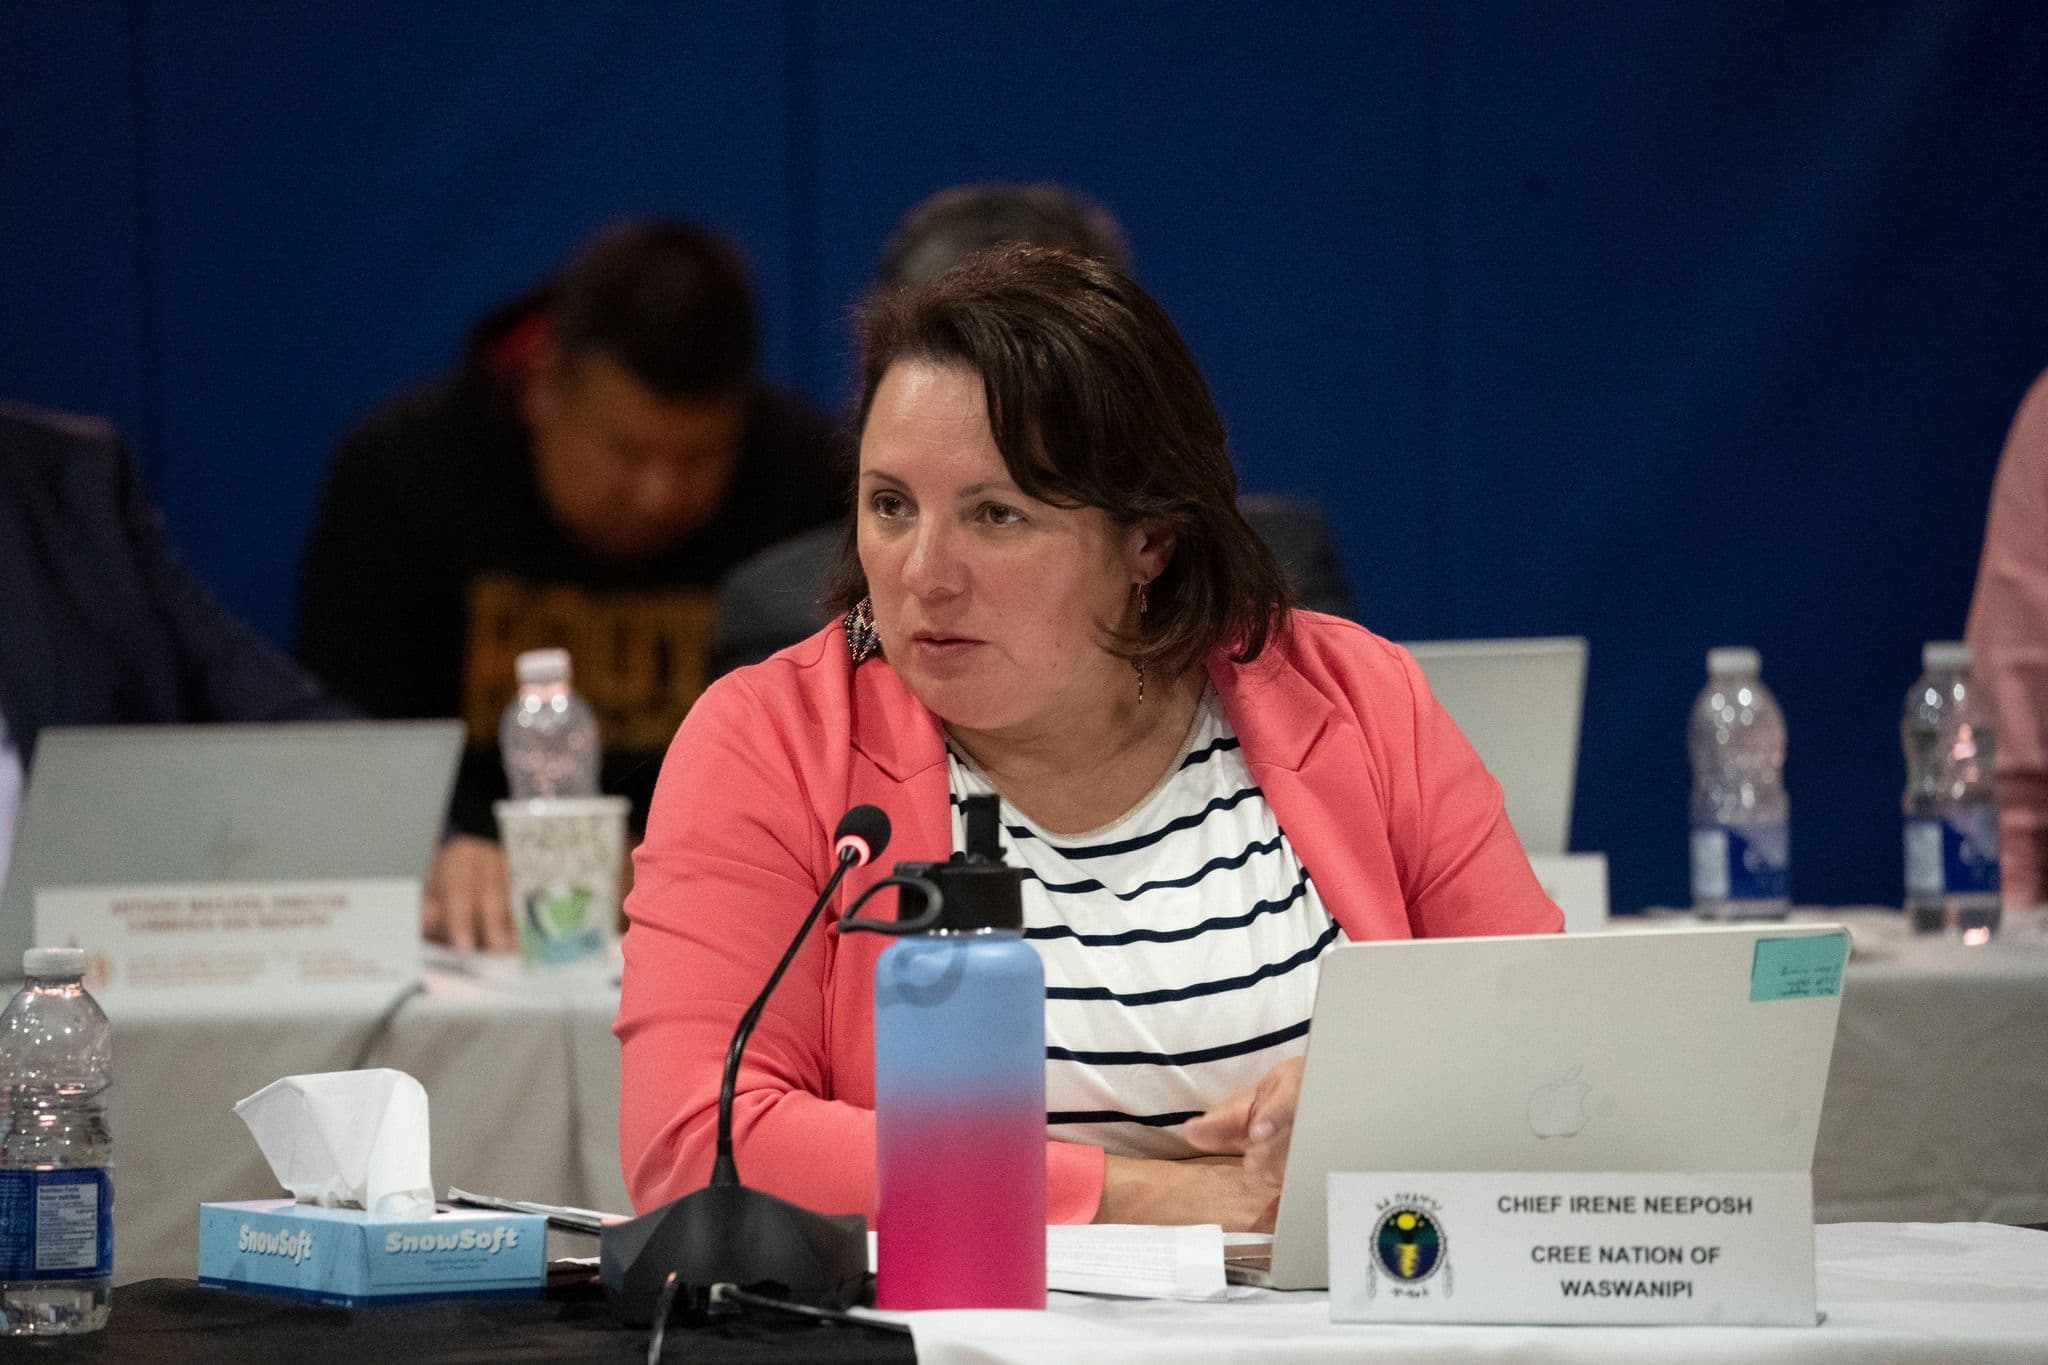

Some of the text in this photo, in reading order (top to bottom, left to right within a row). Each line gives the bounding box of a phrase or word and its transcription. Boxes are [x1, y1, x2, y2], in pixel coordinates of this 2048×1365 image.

[1497, 1196, 1754, 1215] CHIEF IRENE NEEPOSH
[239, 1223, 312, 1267] SnowSoft
[384, 1225, 519, 1256] SnowSoft
[1531, 1245, 1721, 1265] CREE NATION OF
[1560, 1279, 1694, 1299] WASWANIPI
